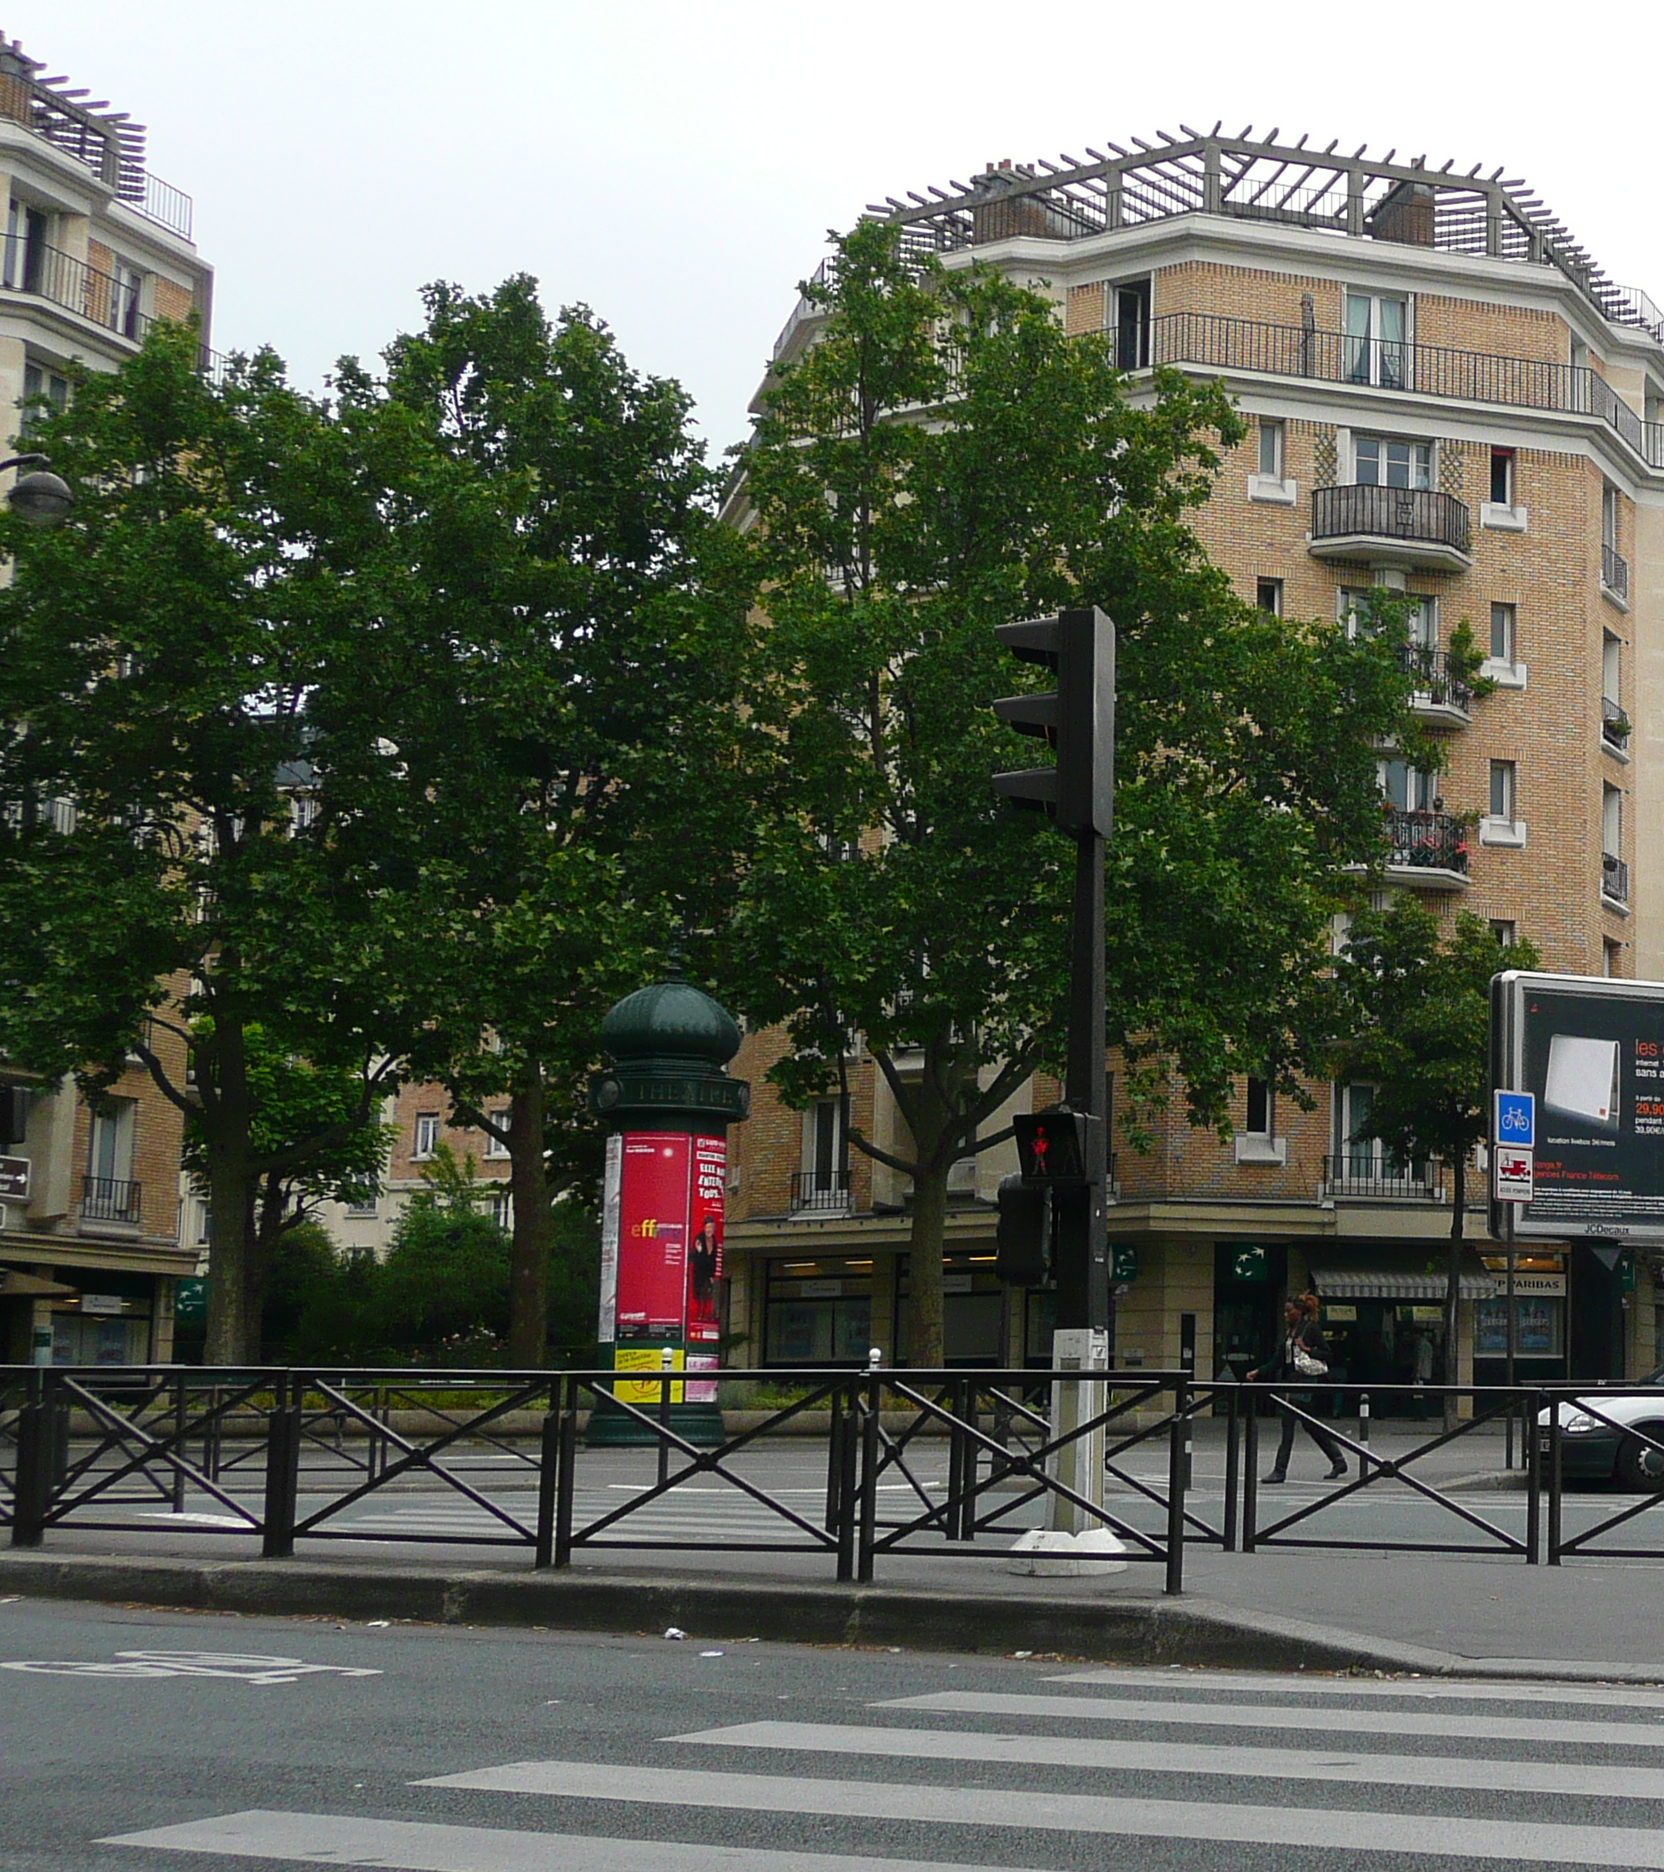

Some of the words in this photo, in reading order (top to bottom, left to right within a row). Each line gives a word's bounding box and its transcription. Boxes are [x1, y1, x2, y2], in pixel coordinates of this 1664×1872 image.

[1635, 1038, 1658, 1056] les
[1635, 1069, 1657, 1078] sans
[1635, 1117, 1662, 1125] pendant
[1584, 1224, 1630, 1235] JCDecaux
